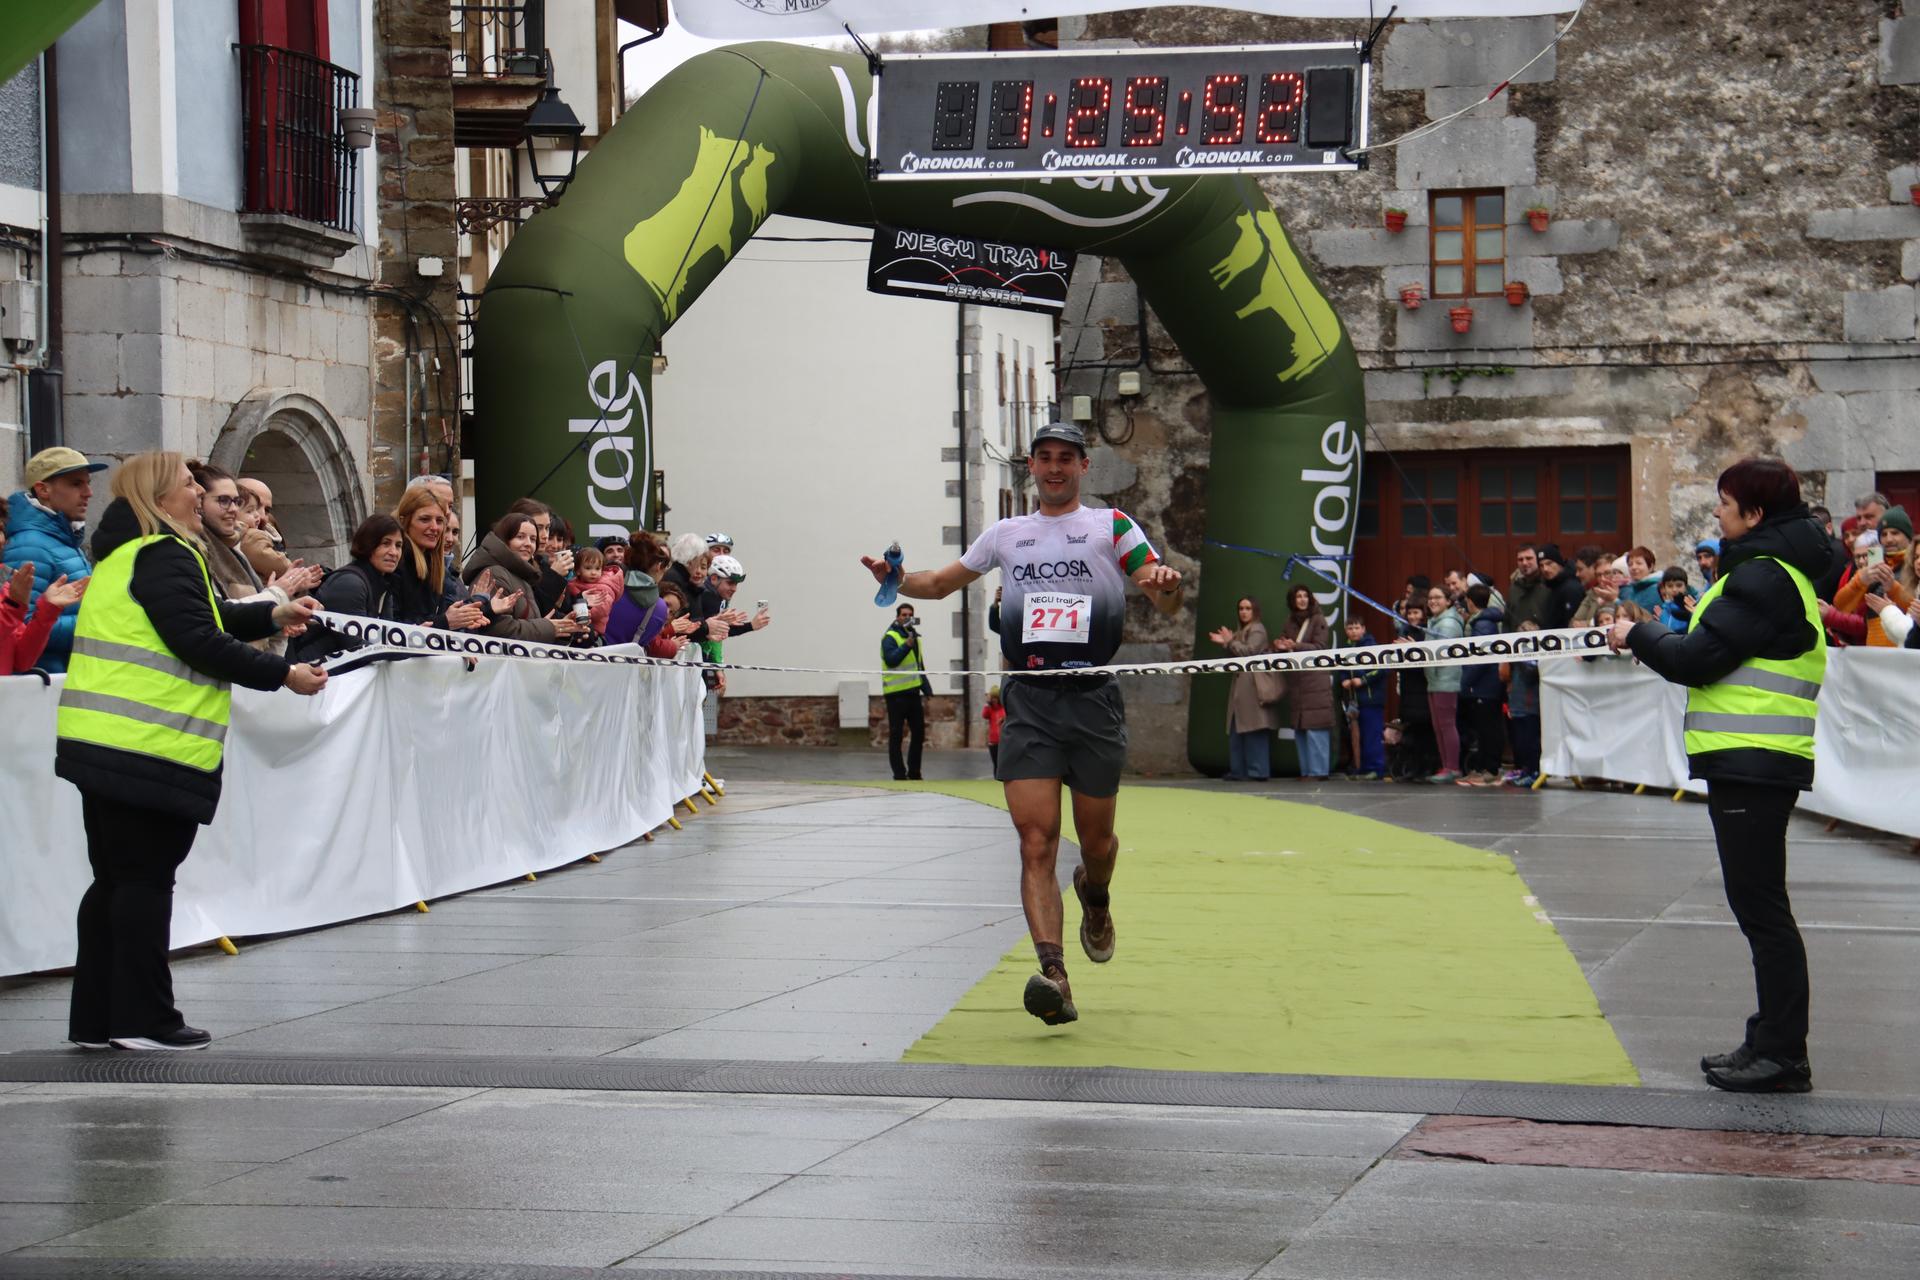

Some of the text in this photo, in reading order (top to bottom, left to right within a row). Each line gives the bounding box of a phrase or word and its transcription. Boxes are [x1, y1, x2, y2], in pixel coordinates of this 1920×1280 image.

[900, 151, 1015, 173] KRONOAK.com
[1041, 149, 1157, 171] KRONOAK.com
[1175, 146, 1293, 168] KRONOAK.com
[896, 230, 975, 260] NEGU
[945, 282, 1024, 305] BERASTEGI
[1012, 560, 1093, 582] CALCOSA
[1031, 595, 1073, 605] NEGU trail
[1030, 608, 1078, 630] 271
[1447, 634, 1562, 658] ataria
